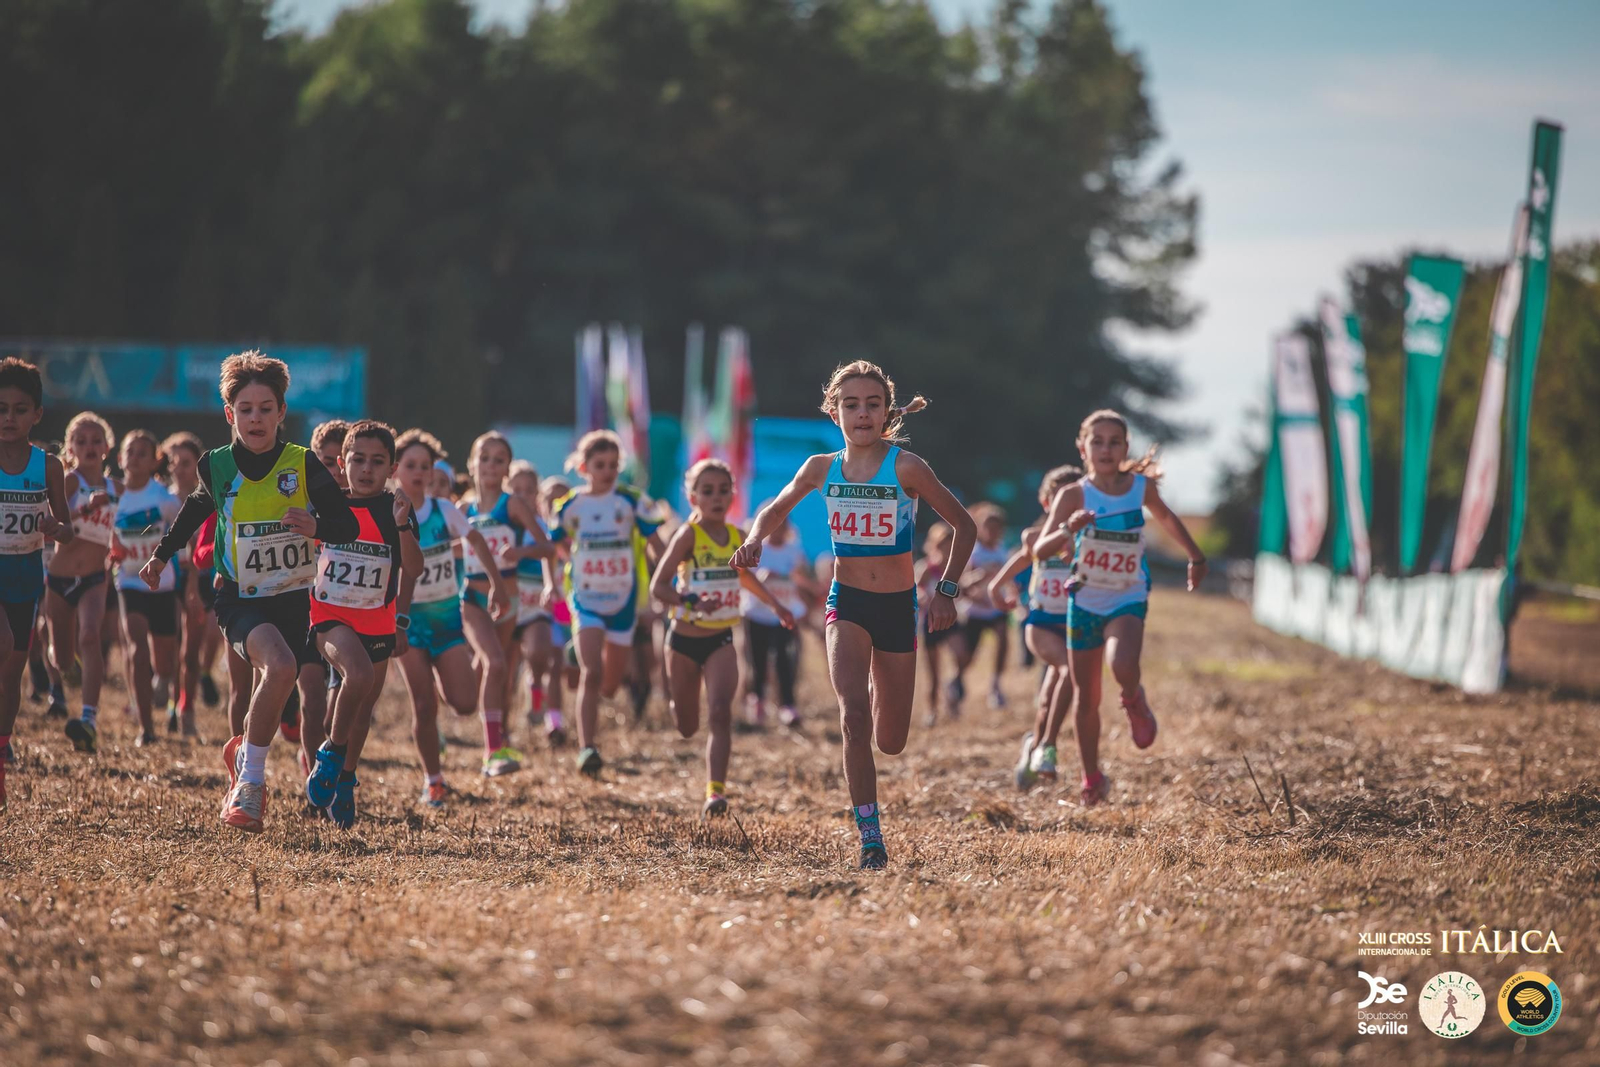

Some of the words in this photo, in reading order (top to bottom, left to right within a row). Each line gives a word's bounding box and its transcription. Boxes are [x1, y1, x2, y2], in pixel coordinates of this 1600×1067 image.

[3, 491, 37, 502] ITÁLICA
[843, 486, 879, 497] ITÁLICA
[831, 511, 894, 538] 4415
[245, 541, 312, 574] 4101
[1083, 549, 1137, 574] 4426
[323, 560, 382, 590] 4211
[415, 560, 453, 586] 278
